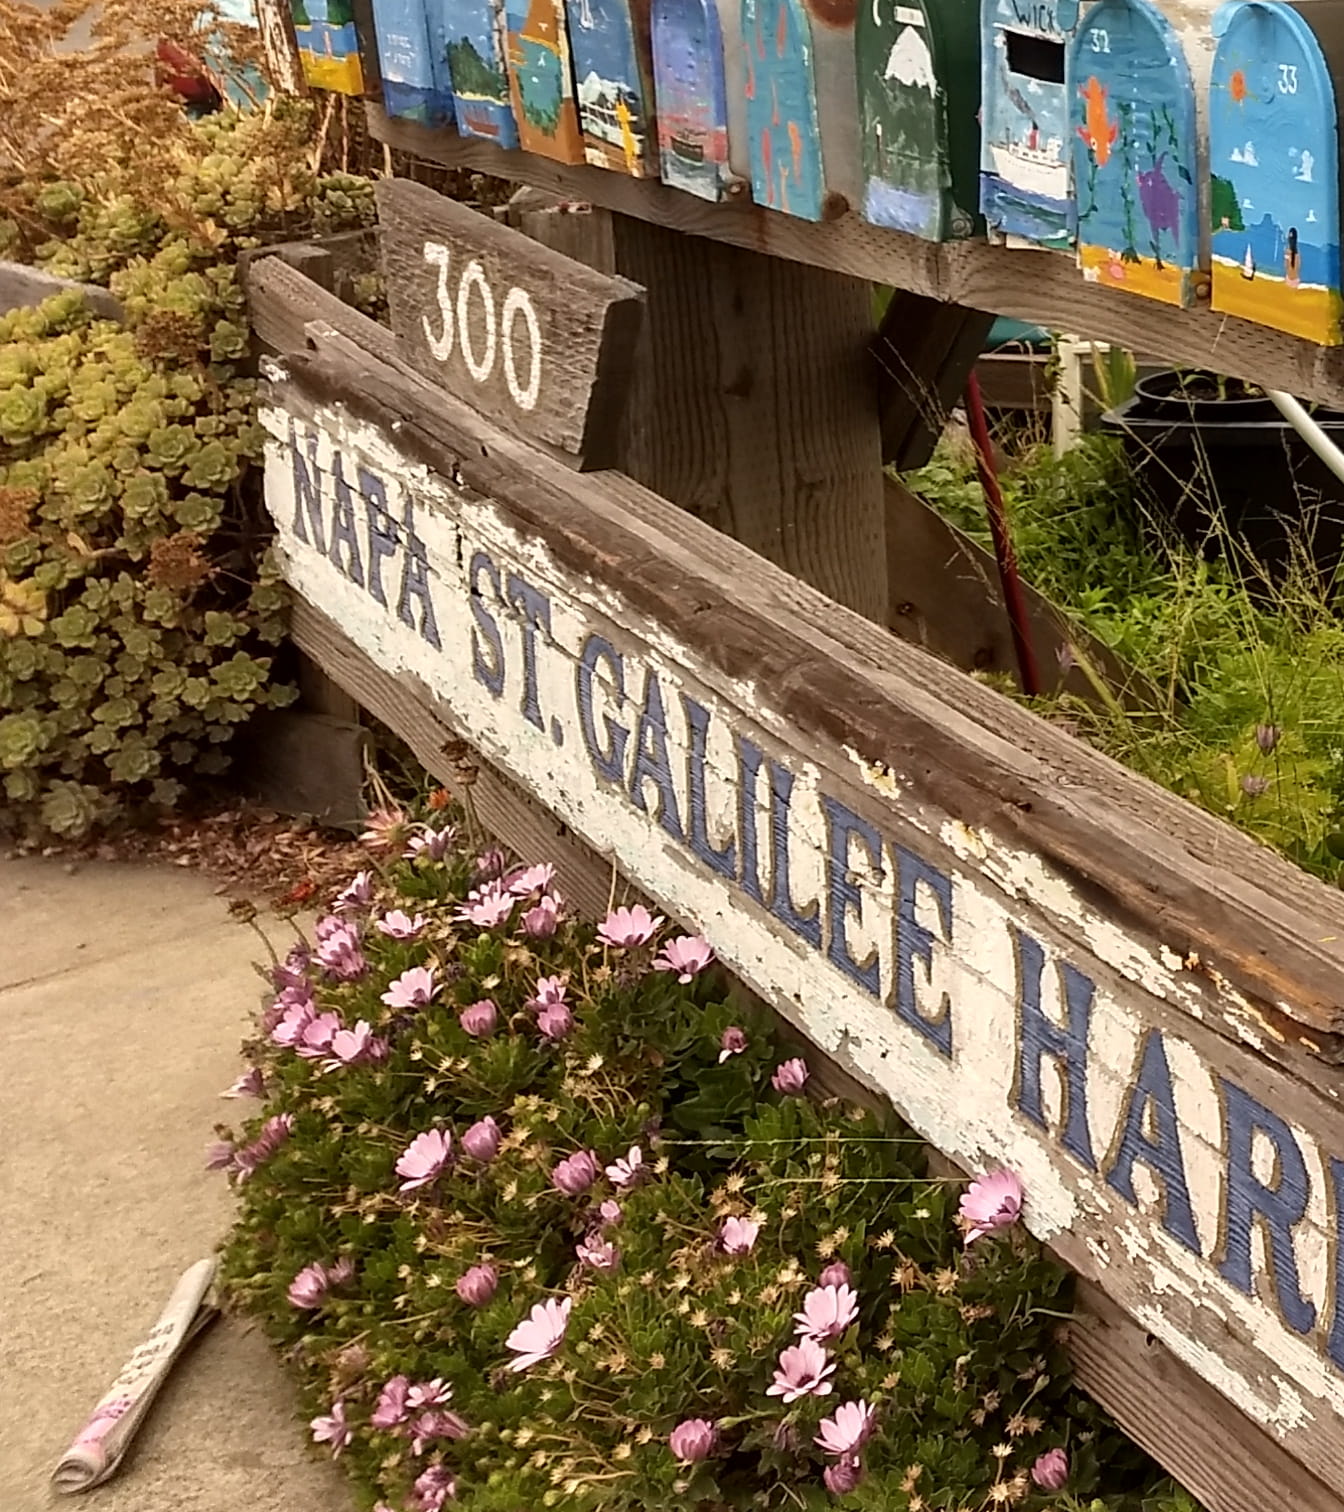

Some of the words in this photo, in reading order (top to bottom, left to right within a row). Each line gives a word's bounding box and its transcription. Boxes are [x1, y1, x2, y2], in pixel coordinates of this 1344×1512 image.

[1090, 28, 1111, 53] 32
[1278, 64, 1297, 94] 33
[421, 242, 542, 410] 300
[288, 427, 444, 651] NAPA
[470, 550, 565, 747] ST.
[577, 636, 955, 1060] GALILEE
